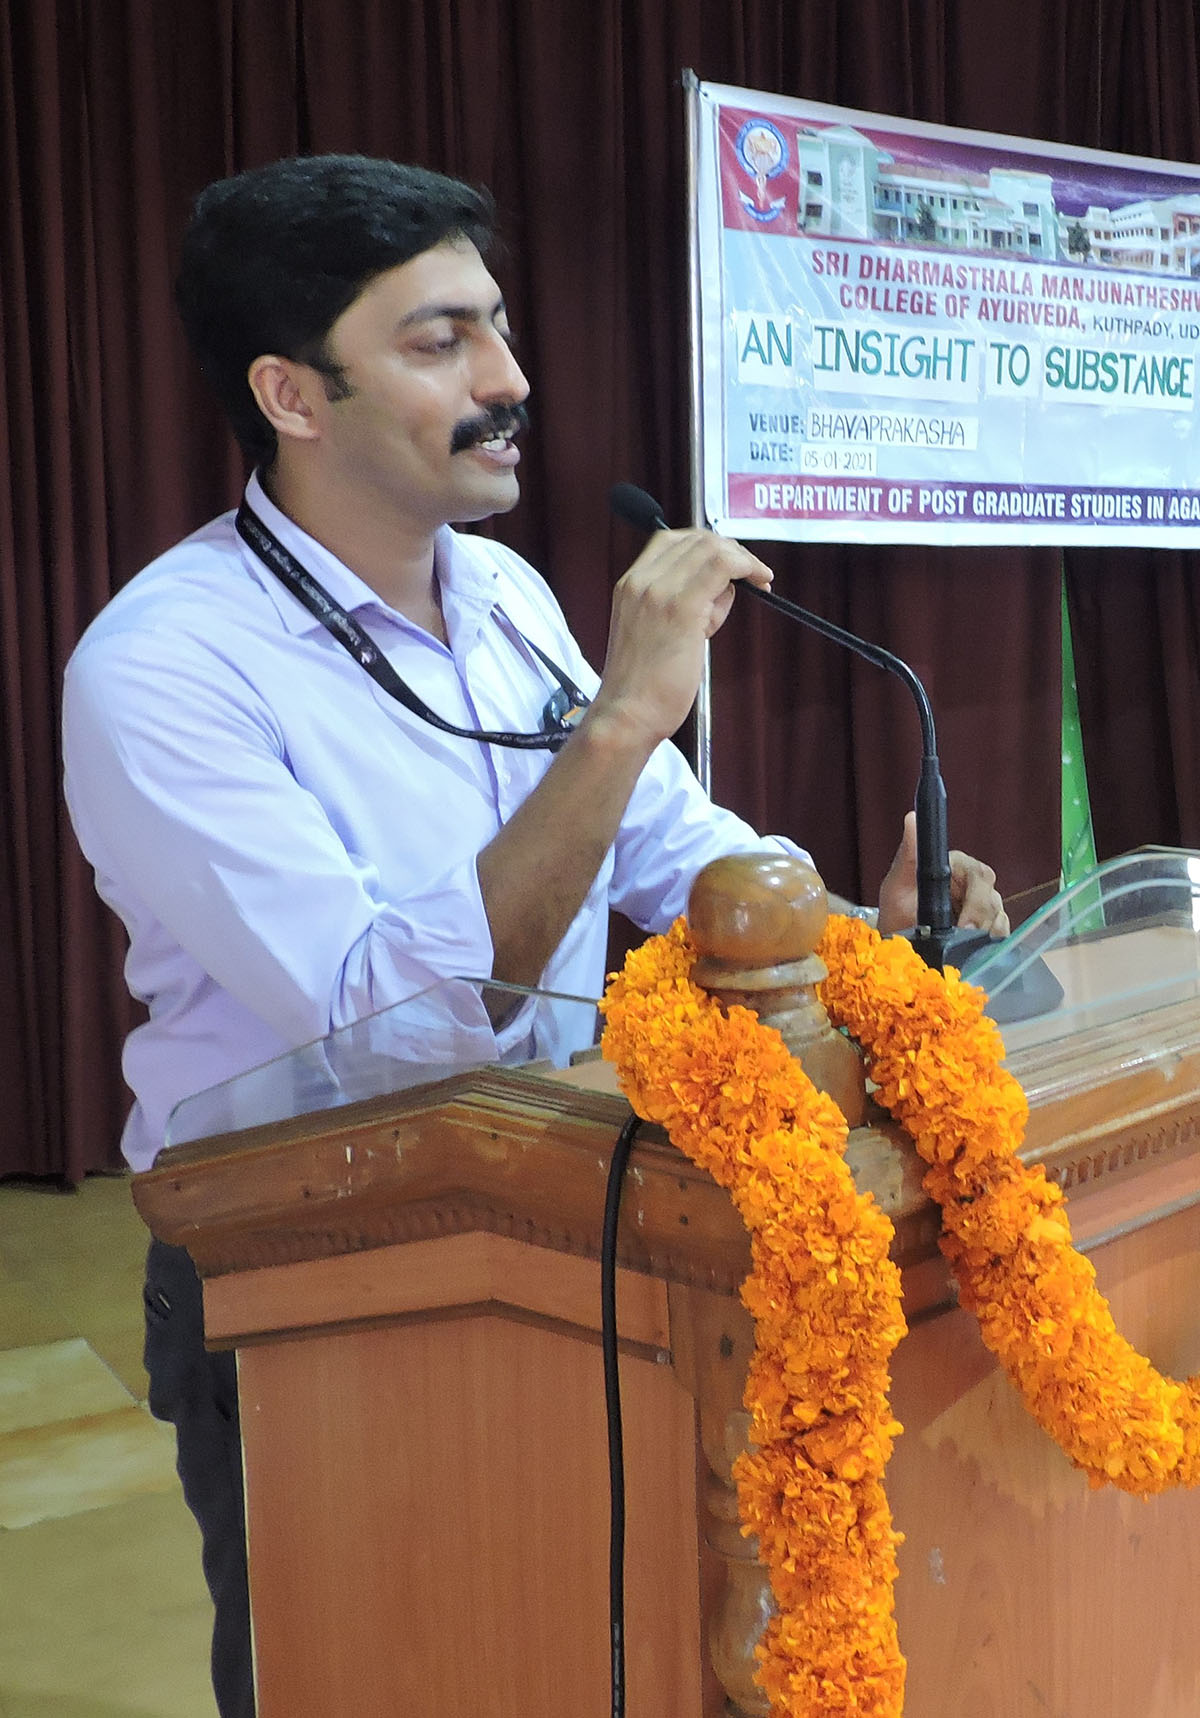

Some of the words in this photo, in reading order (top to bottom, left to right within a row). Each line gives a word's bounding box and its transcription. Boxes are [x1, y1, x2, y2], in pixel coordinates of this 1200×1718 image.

[811, 249, 849, 277] SRI
[859, 254, 1034, 297] DHARMASTHALA
[839, 283, 937, 316] COLLEGE
[945, 294, 970, 319] OF
[978, 296, 1087, 333] AYURVEDA,
[1093, 316, 1174, 340] KUTHPADY,
[741, 319, 793, 366] AN
[814, 325, 975, 382] INSIGHT
[990, 343, 1031, 386] TO
[1045, 346, 1193, 398] SUBSTANCE
[749, 413, 804, 434] VENUE:
[811, 412, 965, 446] BHAVAPRAKASHA
[750, 441, 793, 461] DATE:
[754, 483, 883, 512] DEPARTMENT
[888, 488, 913, 513] OF
[919, 488, 967, 514] POST
[972, 490, 1066, 518] GRADUATE
[1070, 494, 1142, 519] STUDIES
[1147, 496, 1164, 519] IN
